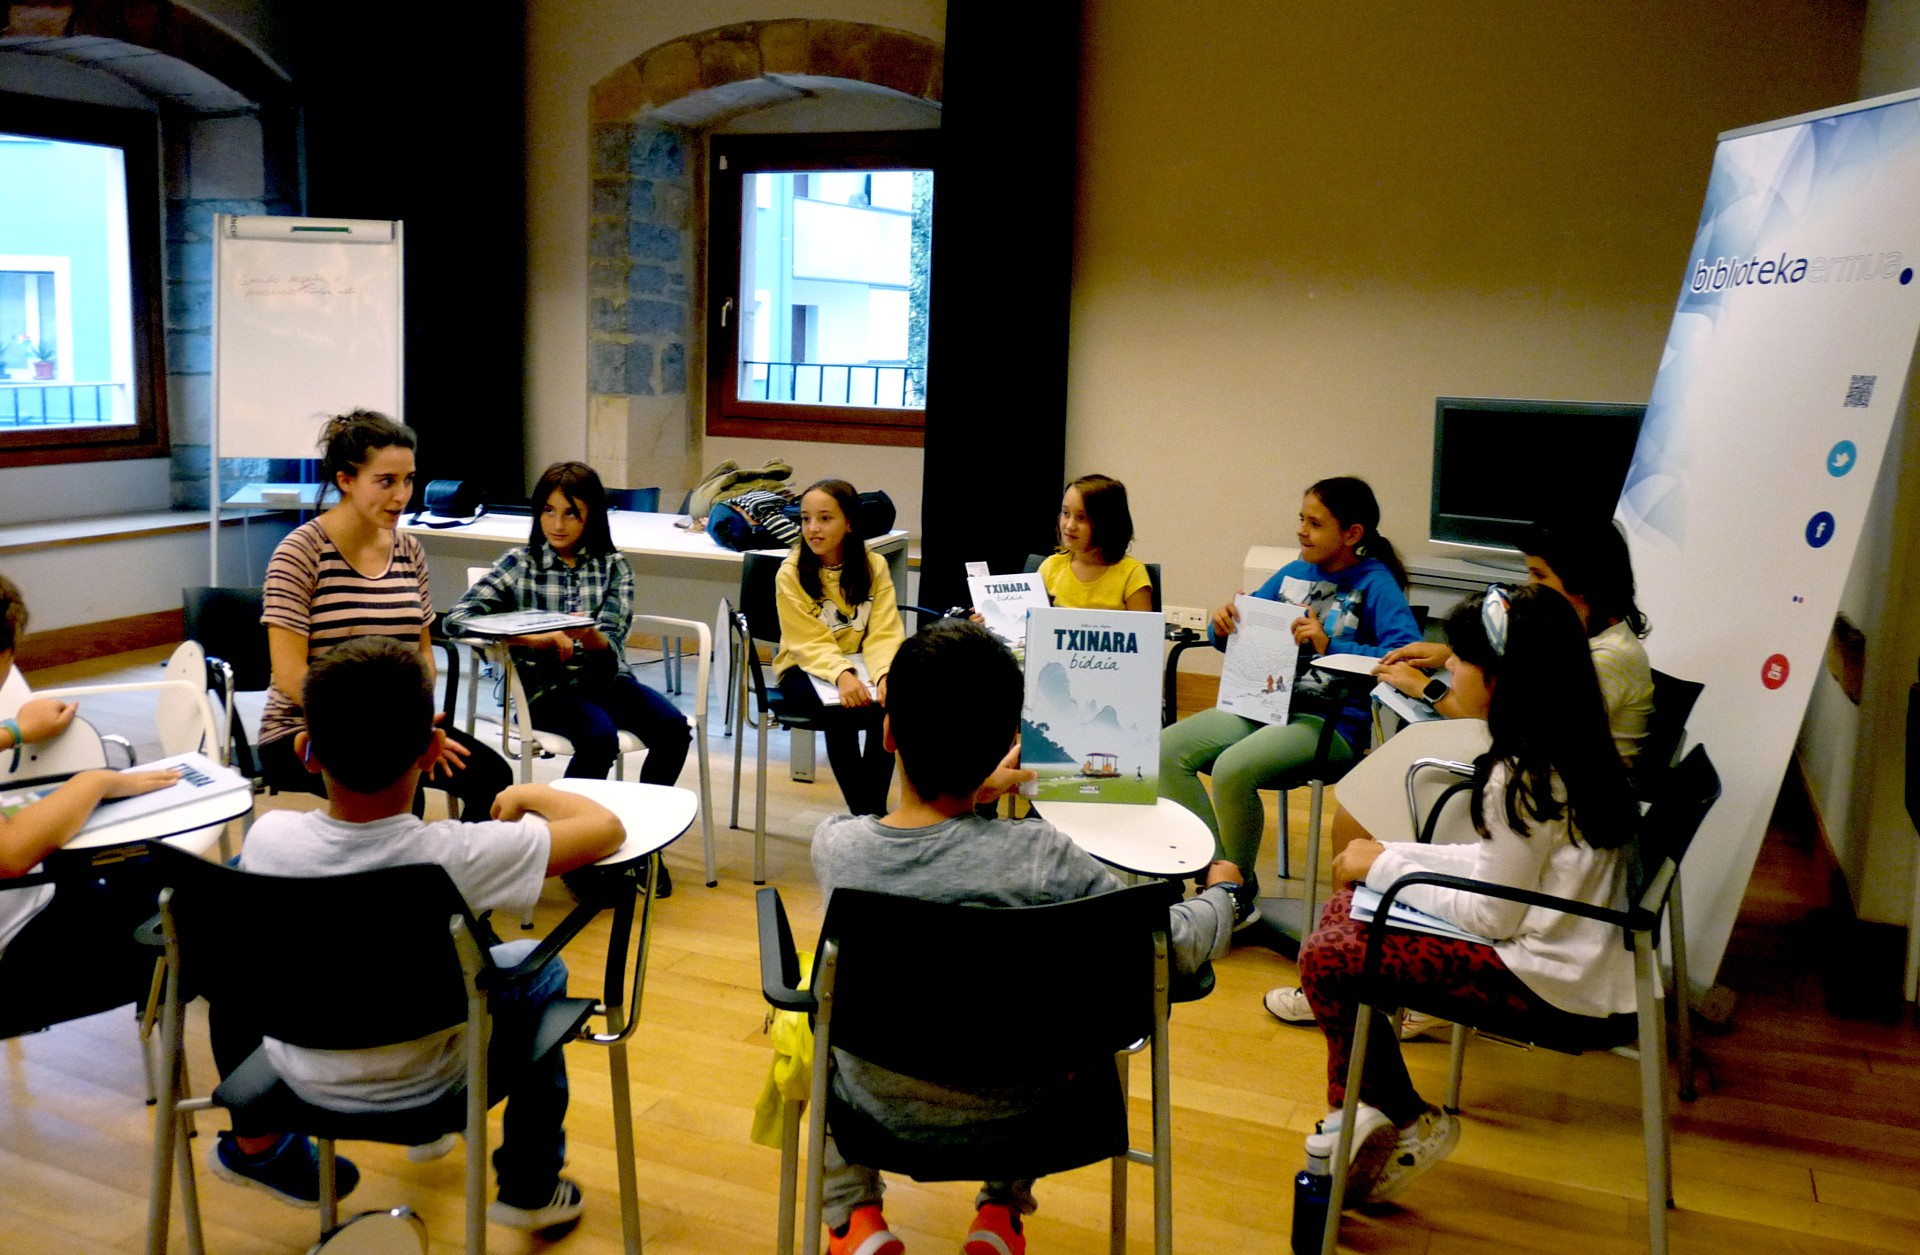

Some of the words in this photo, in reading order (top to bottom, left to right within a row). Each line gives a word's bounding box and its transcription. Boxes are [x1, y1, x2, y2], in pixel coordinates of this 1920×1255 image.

[984, 582, 1031, 594] TXINARA
[1054, 628, 1138, 653] TXINARA
[1069, 653, 1120, 671] bidaia
